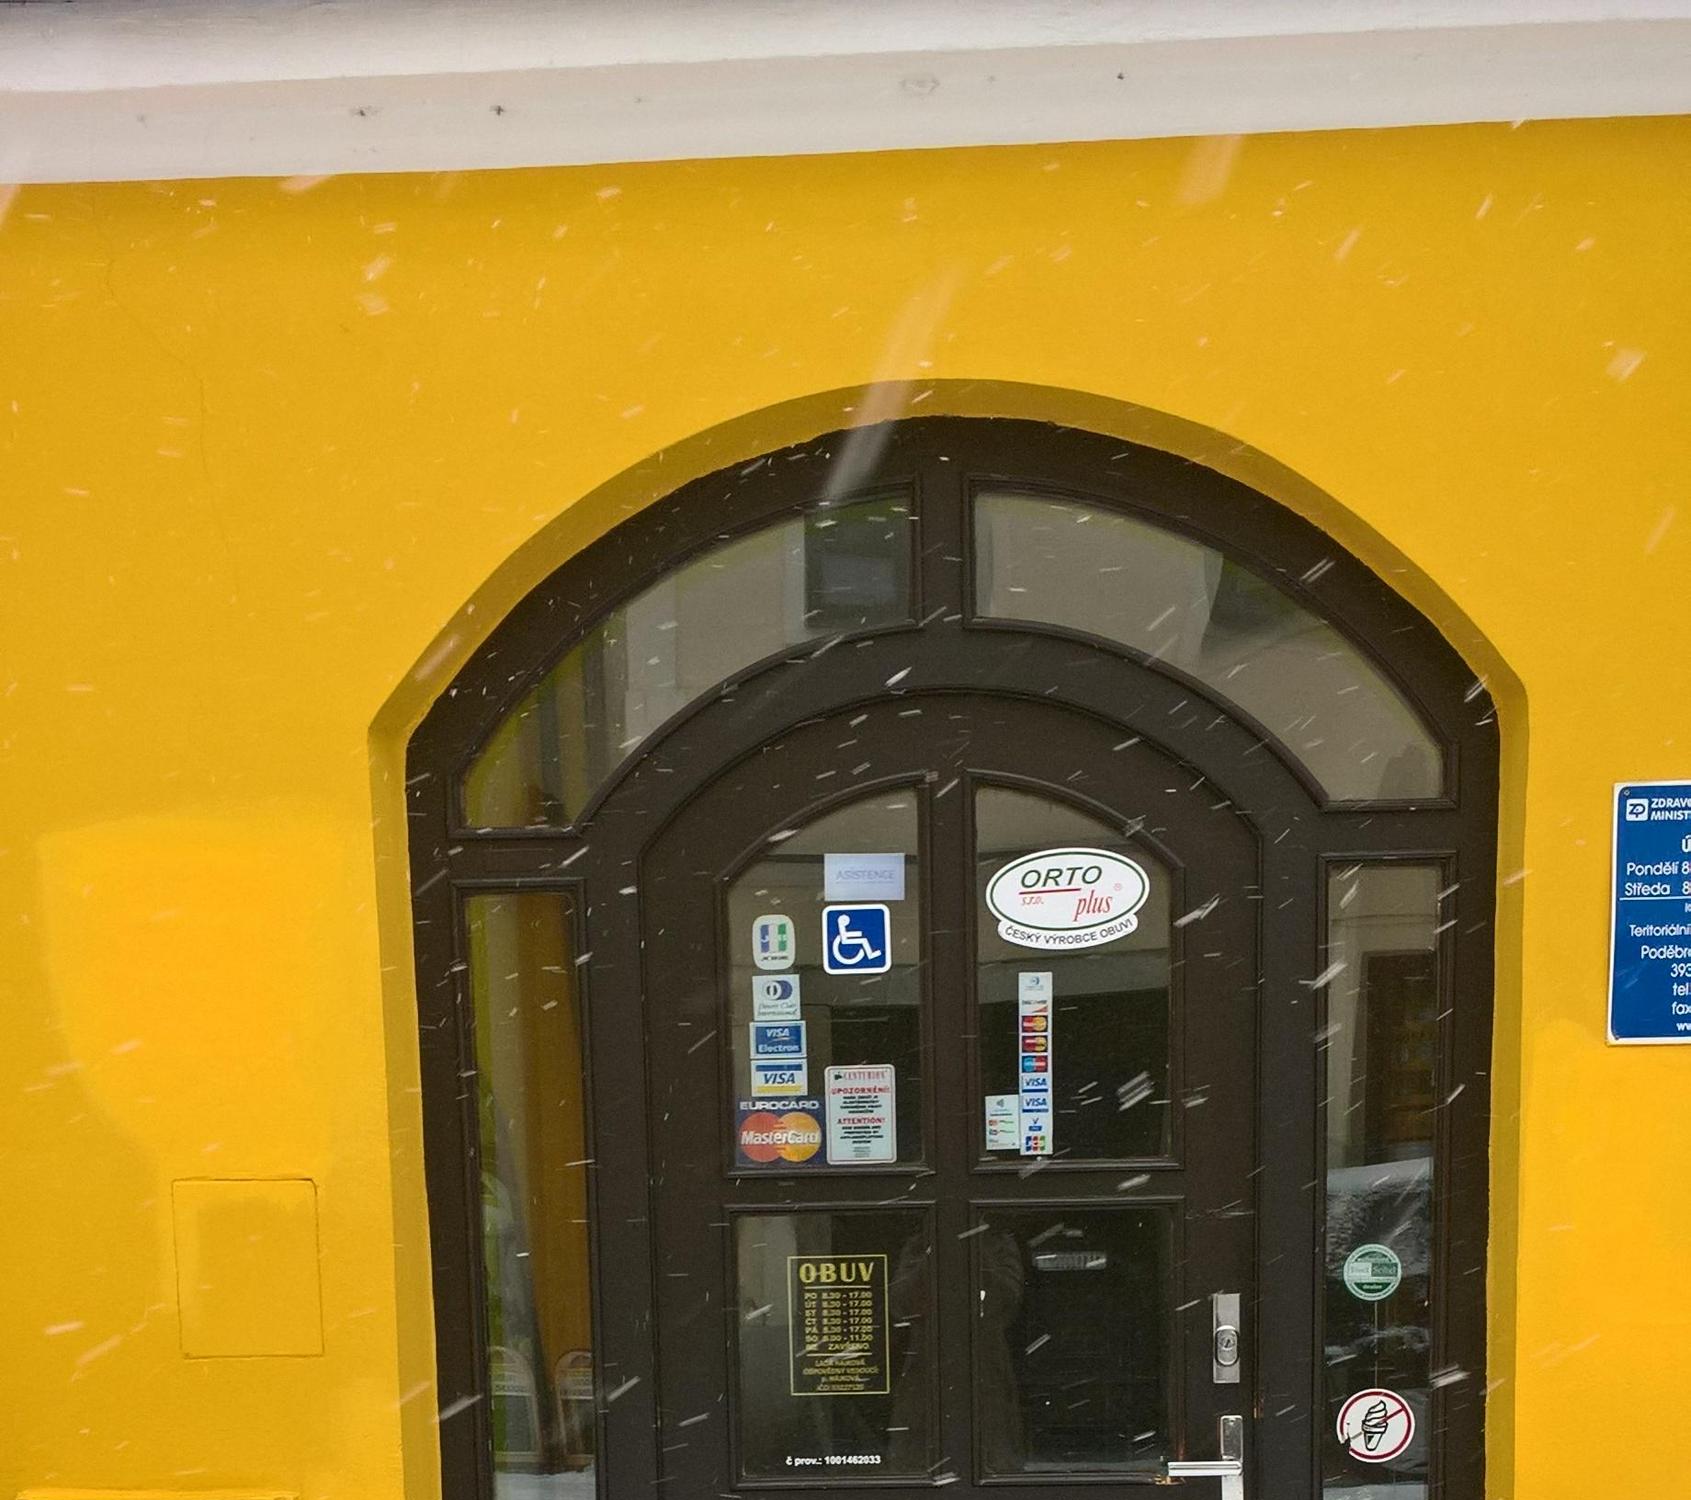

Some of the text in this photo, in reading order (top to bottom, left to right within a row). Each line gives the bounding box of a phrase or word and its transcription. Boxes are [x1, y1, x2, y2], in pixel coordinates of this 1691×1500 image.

[835, 869, 895, 880] ASISTENCE
[1626, 861, 1679, 876] Pondělí
[1021, 865, 1103, 888] ORTO
[1625, 882, 1670, 896] Středa
[1073, 889, 1113, 922] plus
[1005, 918, 1134, 945] ČESKÝ VÝROBCE OBUVI
[765, 1028, 790, 1037] VISA
[758, 1043, 800, 1053] Electron
[764, 1072, 796, 1084] VISA
[1025, 1078, 1048, 1086] VISA
[740, 1101, 819, 1110] EUROCARD
[1025, 1098, 1048, 1106] VISA
[741, 1130, 820, 1145] MasterCard
[799, 1261, 874, 1283] OBUV
[786, 1456, 792, 1466] č
